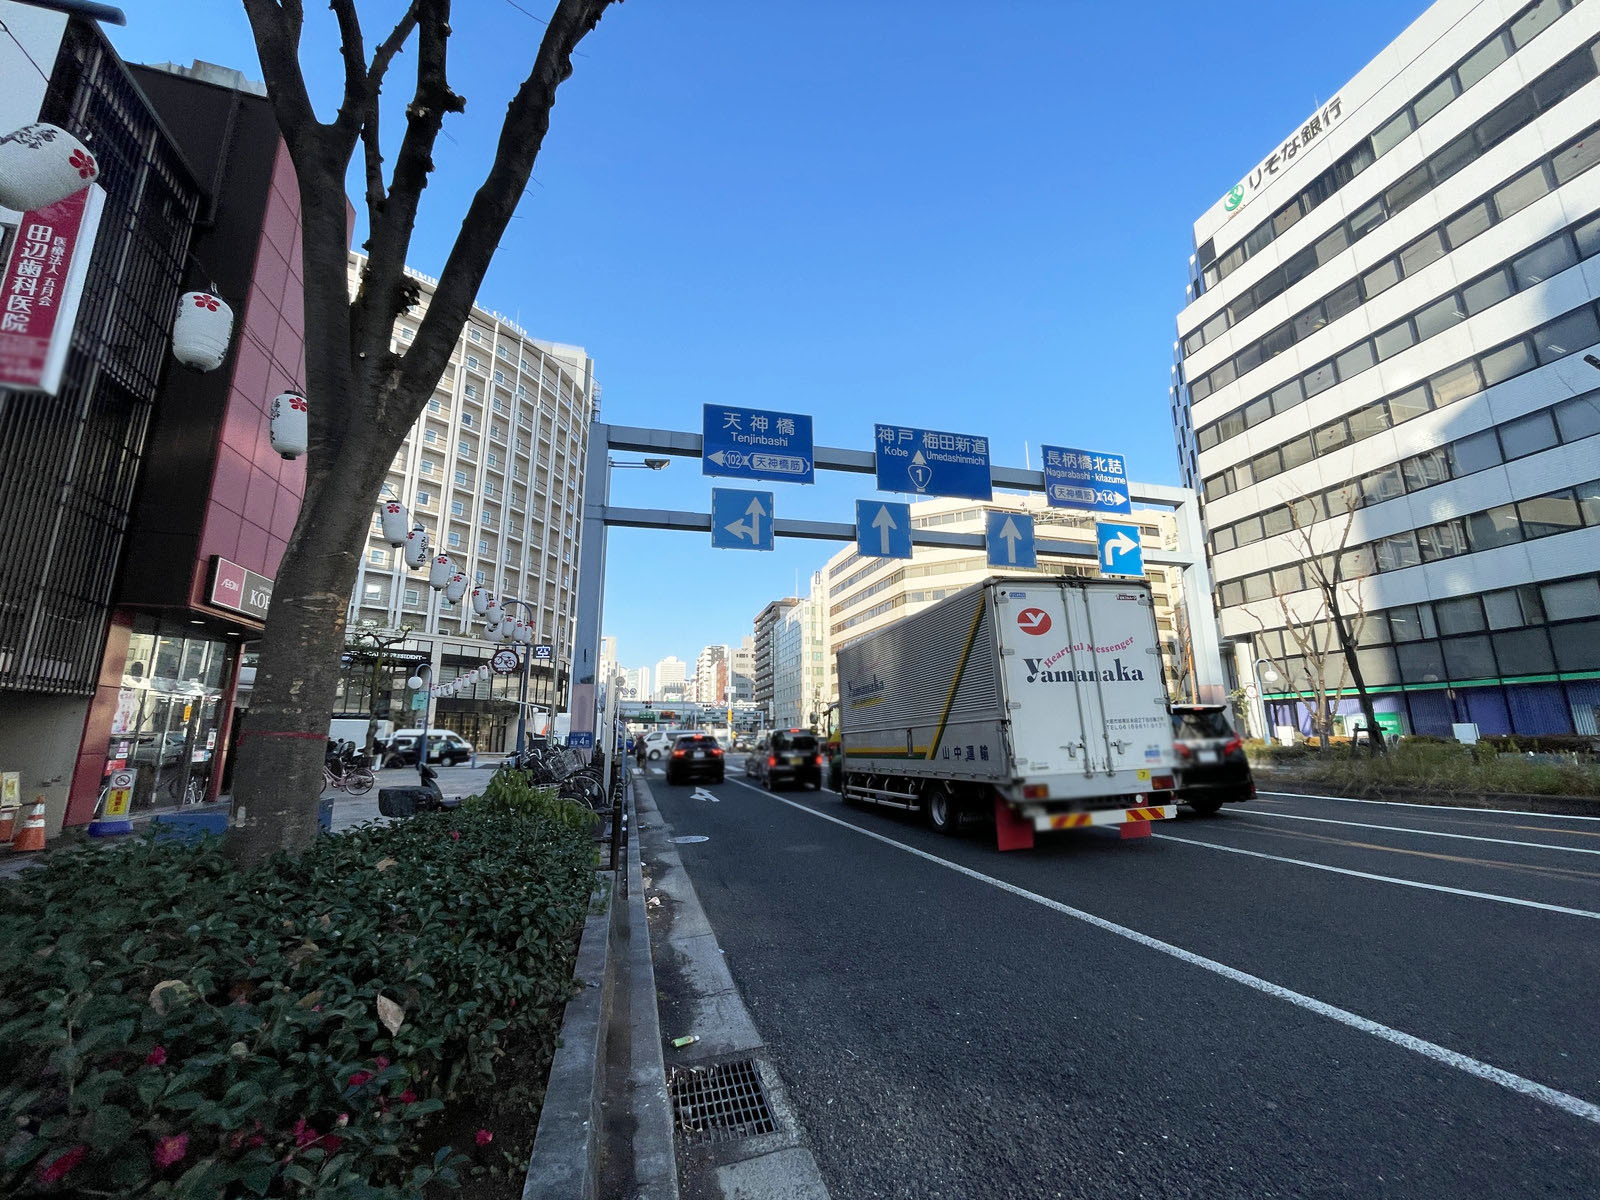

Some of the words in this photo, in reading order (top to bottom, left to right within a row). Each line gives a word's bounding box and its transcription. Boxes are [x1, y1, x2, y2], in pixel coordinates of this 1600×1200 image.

[1249, 97, 1342, 190] りそな銀行
[47, 236, 67, 275] 医療法人
[1, 224, 53, 333] 田辺歯科医院
[38, 277, 57, 307] 五月会
[722, 412, 795, 436] 天神橋
[731, 431, 788, 447] Tenjinbashi
[878, 427, 914, 445] 神戸
[922, 431, 988, 455] 梅田新道
[727, 453, 741, 465] 102
[756, 456, 800, 471] 天神橋筋
[884, 445, 909, 457] Kobe
[926, 450, 985, 466] Umedashinmichi
[1046, 450, 1123, 475] 長柄橋北詰
[916, 468, 923, 482] 1
[1102, 492, 1113, 503] 14
[1023, 658, 1145, 684] Yamanaka
